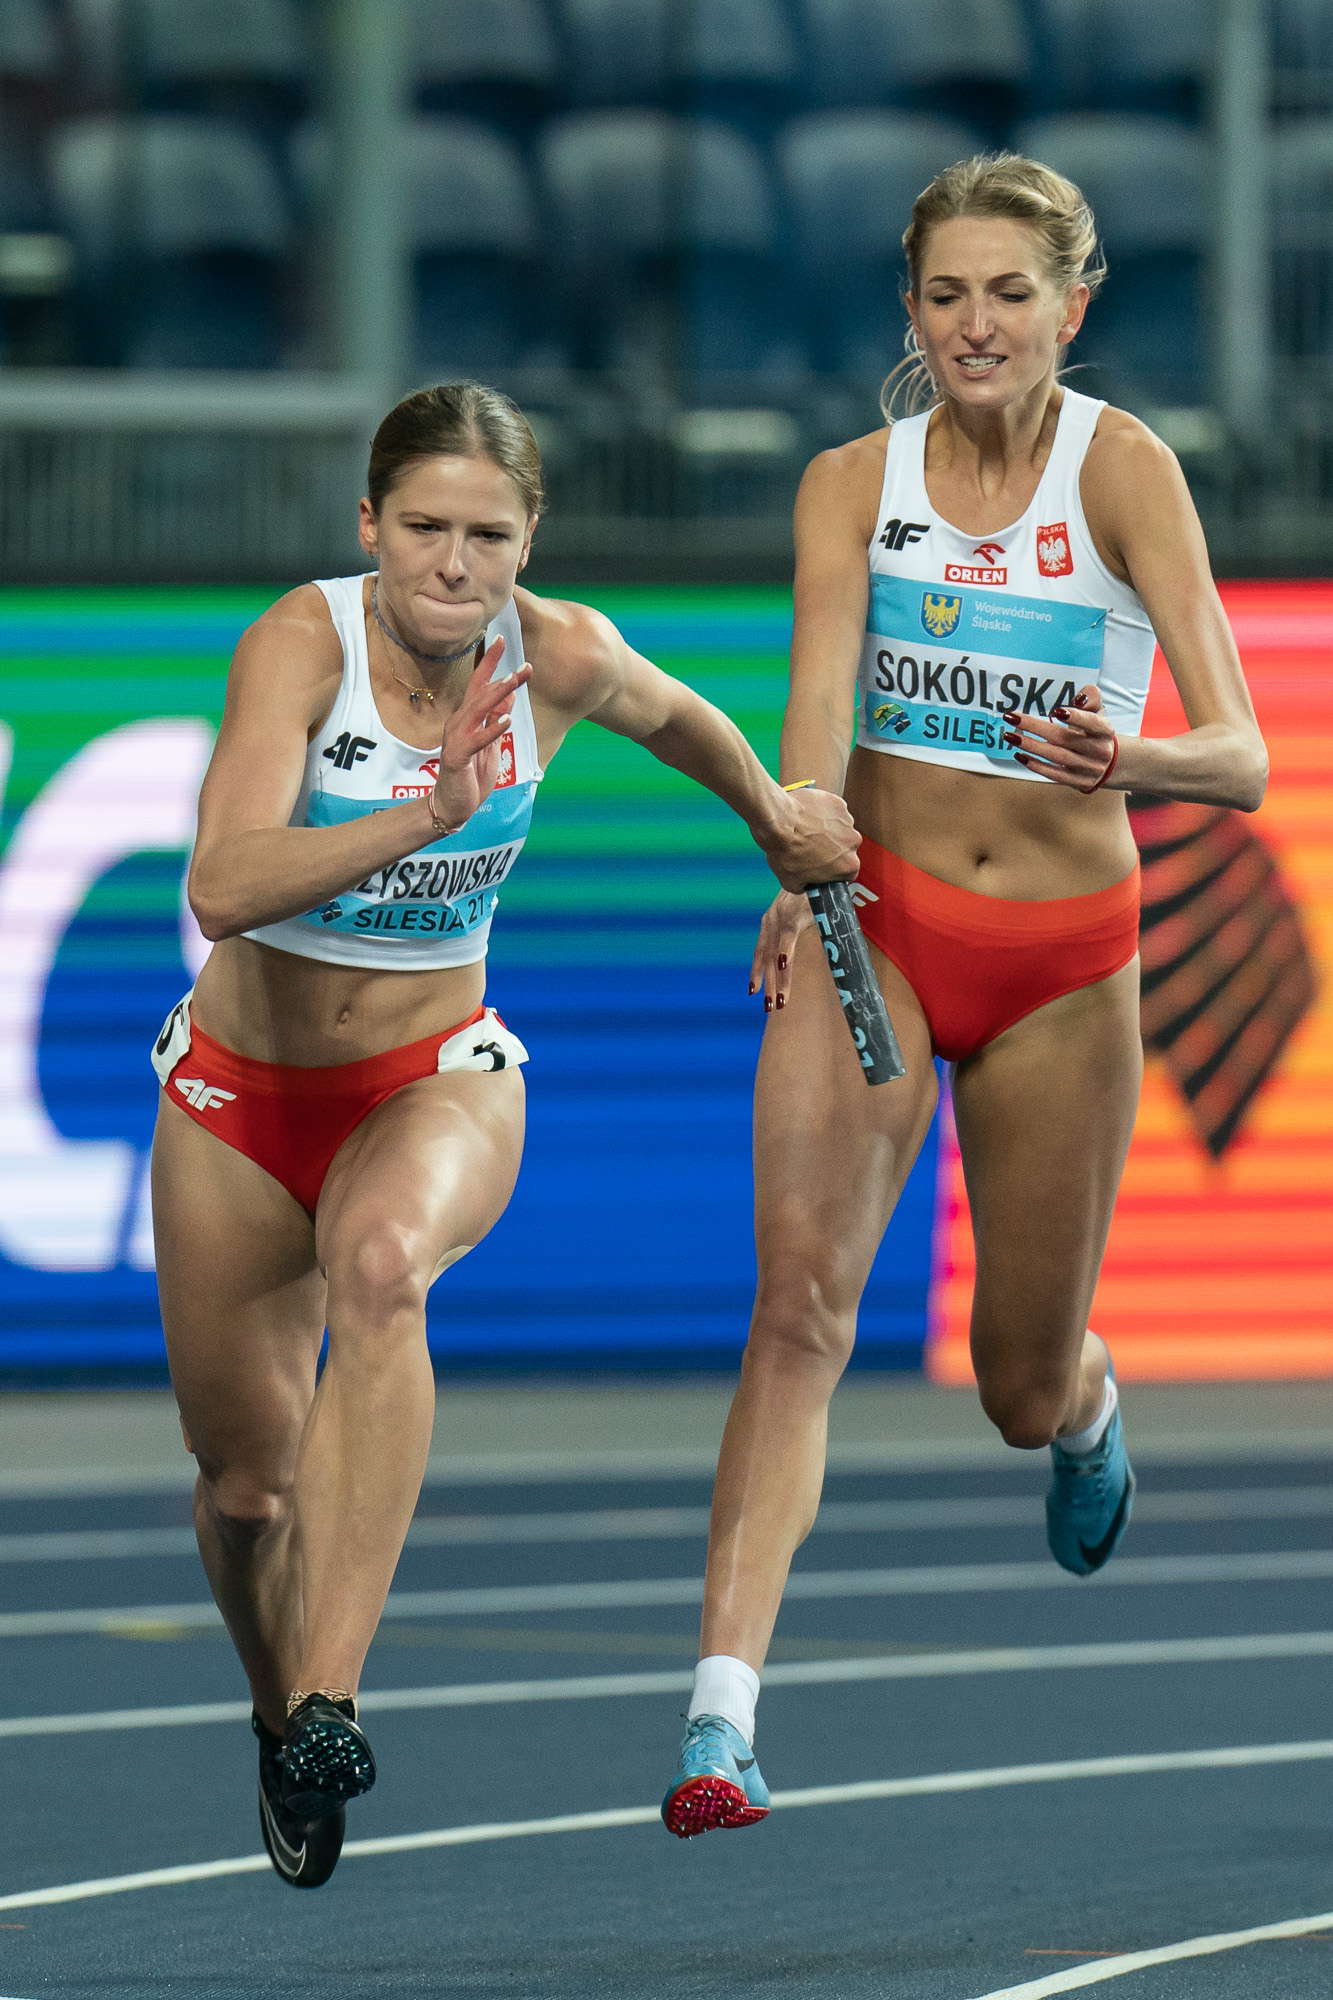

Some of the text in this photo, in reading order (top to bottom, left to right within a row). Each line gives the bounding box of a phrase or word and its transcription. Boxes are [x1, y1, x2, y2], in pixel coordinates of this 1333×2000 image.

[947, 566, 1005, 584] ORLEN
[971, 614, 1012, 632] Śląskie
[974, 600, 1053, 623] Województwo
[875, 649, 1077, 719] SOKÓLSKA
[322, 731, 378, 771] 4F
[353, 907, 465, 932] SILESIA
[174, 1078, 238, 1112] 4F
